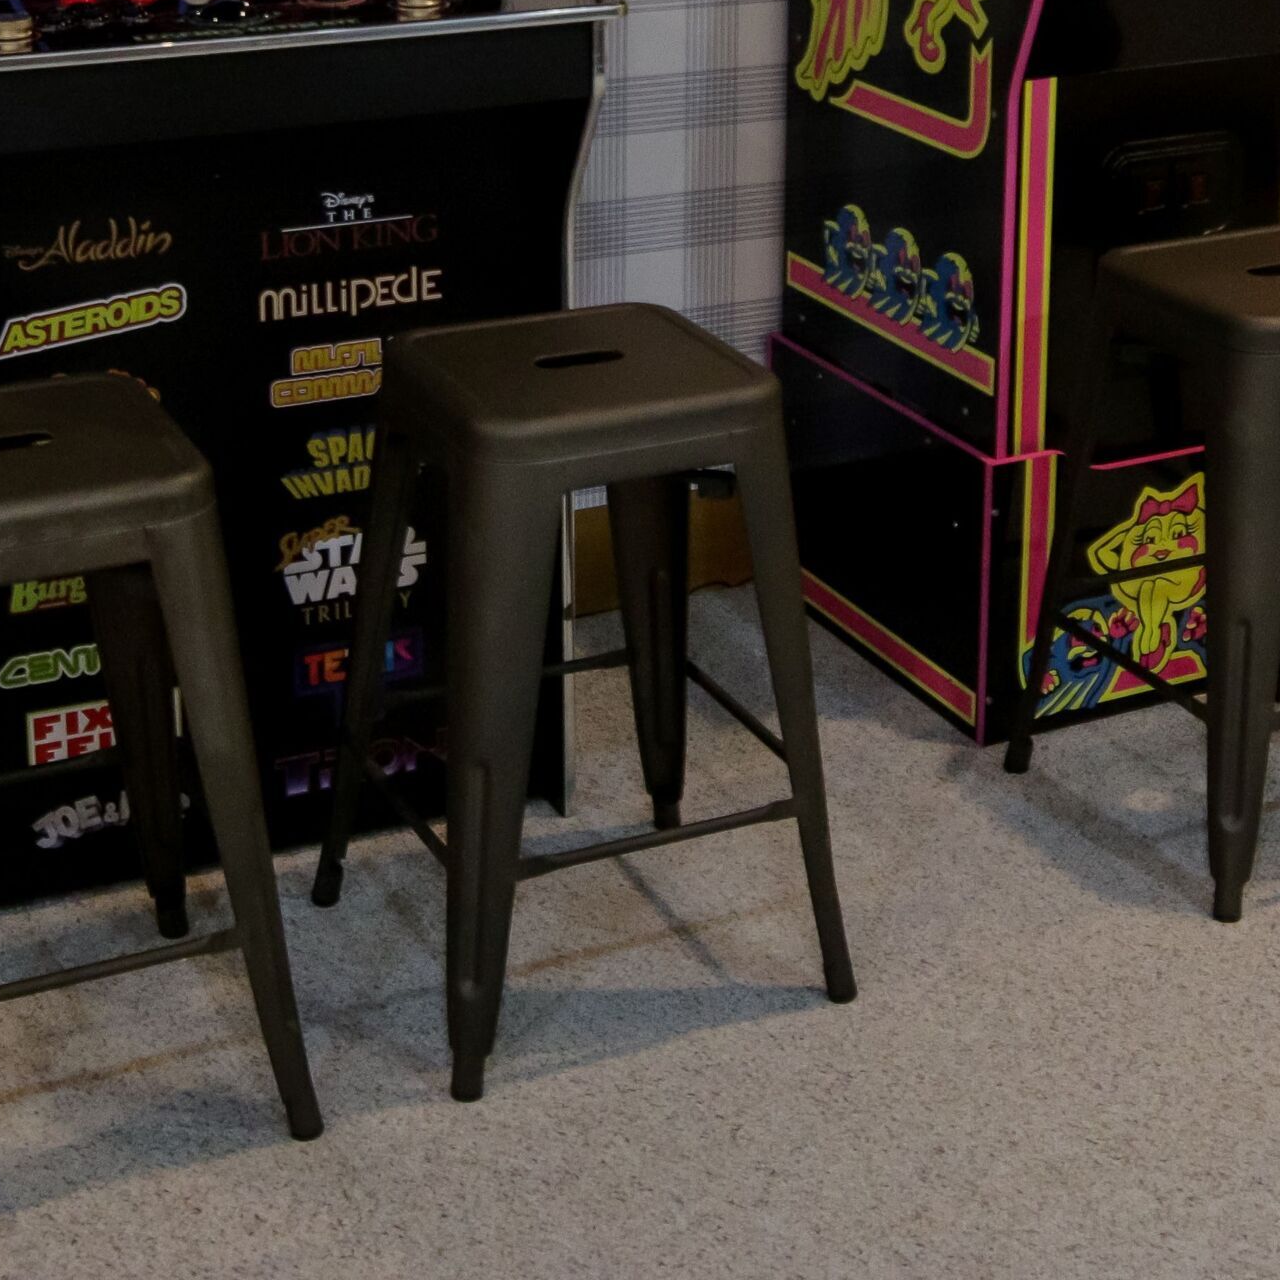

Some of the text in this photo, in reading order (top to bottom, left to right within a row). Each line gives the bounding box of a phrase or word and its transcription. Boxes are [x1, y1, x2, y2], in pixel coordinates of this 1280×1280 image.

[327, 208, 373, 222] THE
[18, 217, 175, 271] Aladdin
[260, 212, 440, 265] LION KING
[2, 284, 183, 354] ASTEROIDS
[272, 368, 382, 407] COMMA
[307, 427, 376, 468] SPA
[280, 465, 371, 500] INVAD
[9, 575, 88, 614] Burg
[33, 707, 114, 742] FIX
[31, 795, 103, 850] JOE
